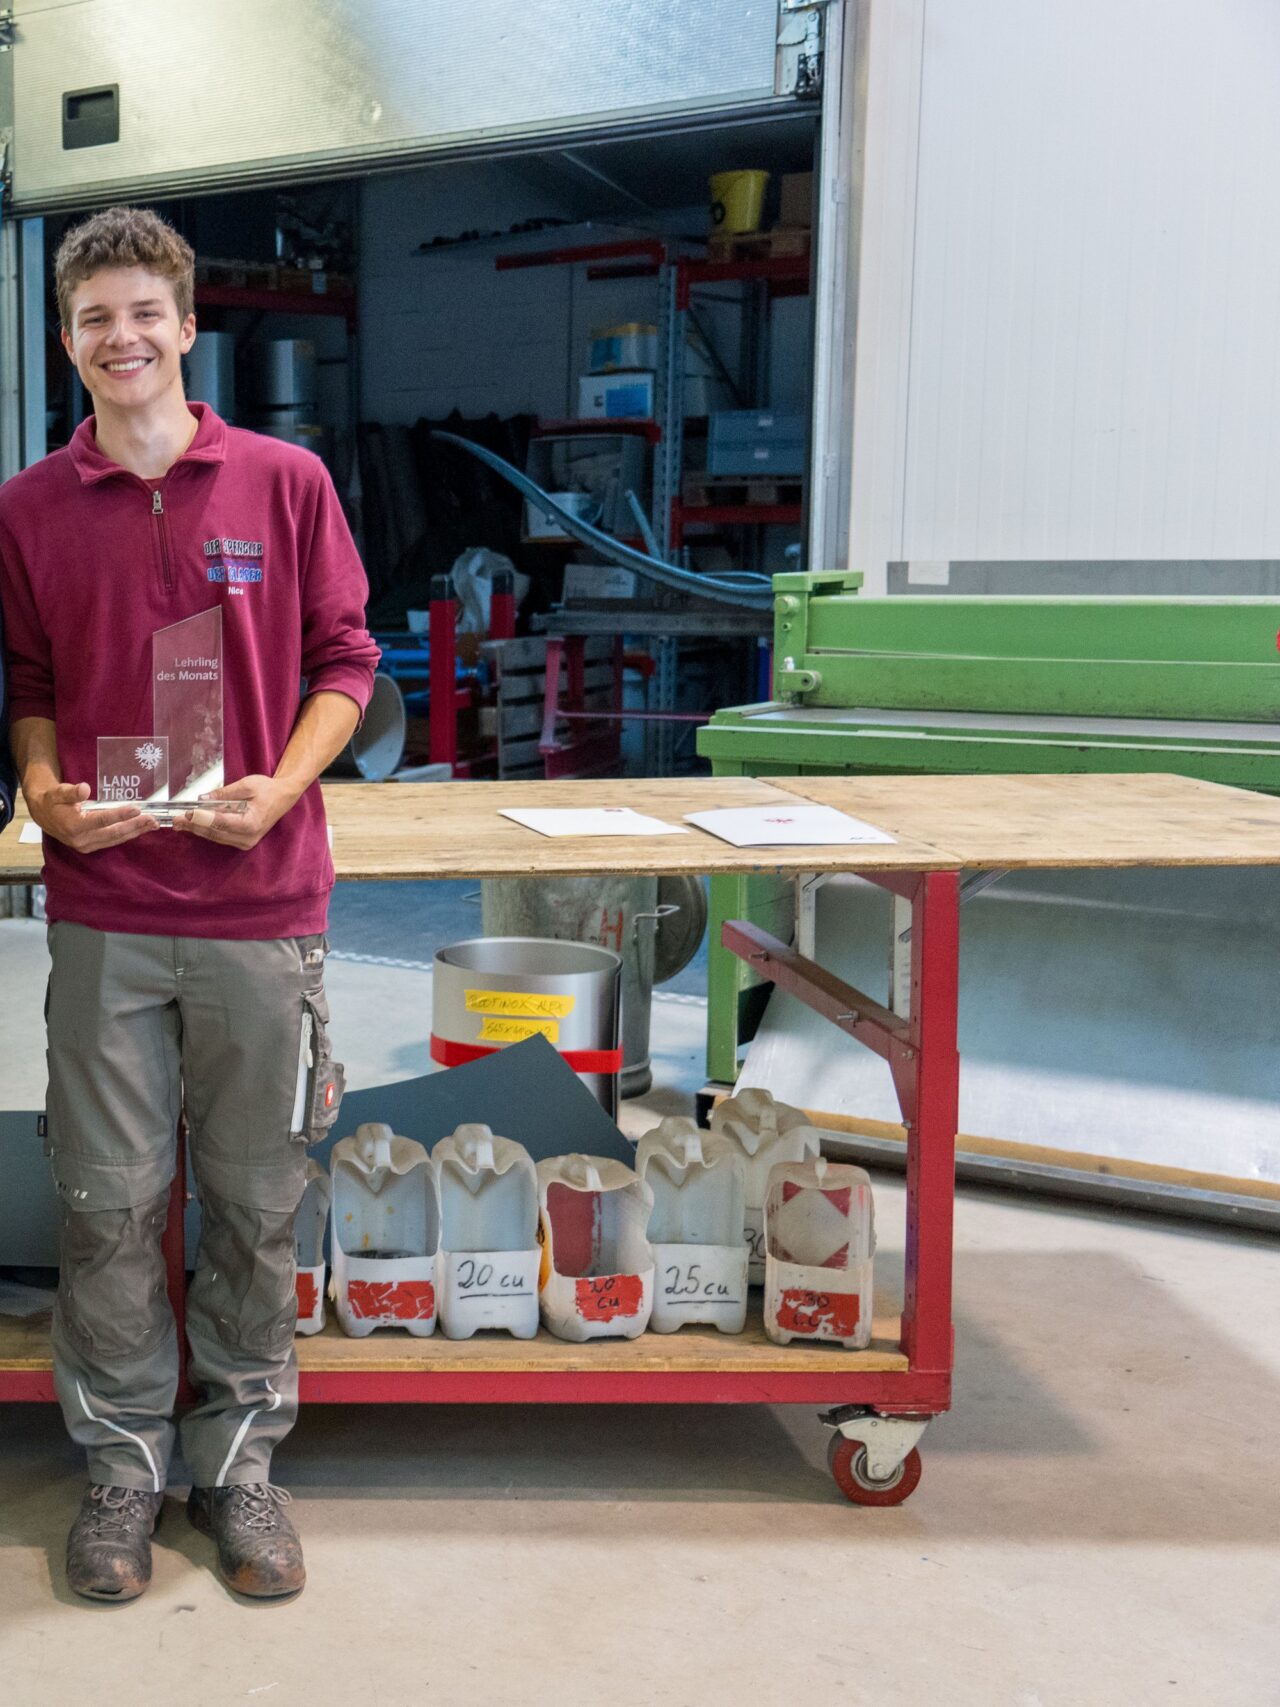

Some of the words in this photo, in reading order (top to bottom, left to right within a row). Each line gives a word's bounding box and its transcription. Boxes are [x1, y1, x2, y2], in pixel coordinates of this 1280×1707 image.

[175, 657, 219, 669] Lehrling
[157, 671, 176, 681] des
[179, 671, 219, 681] Monats
[103, 775, 141, 787] LAND
[103, 788, 142, 800] TIROL
[456, 1260, 493, 1289] 20
[664, 1264, 701, 1295] 25
[588, 1278, 616, 1293] 20
